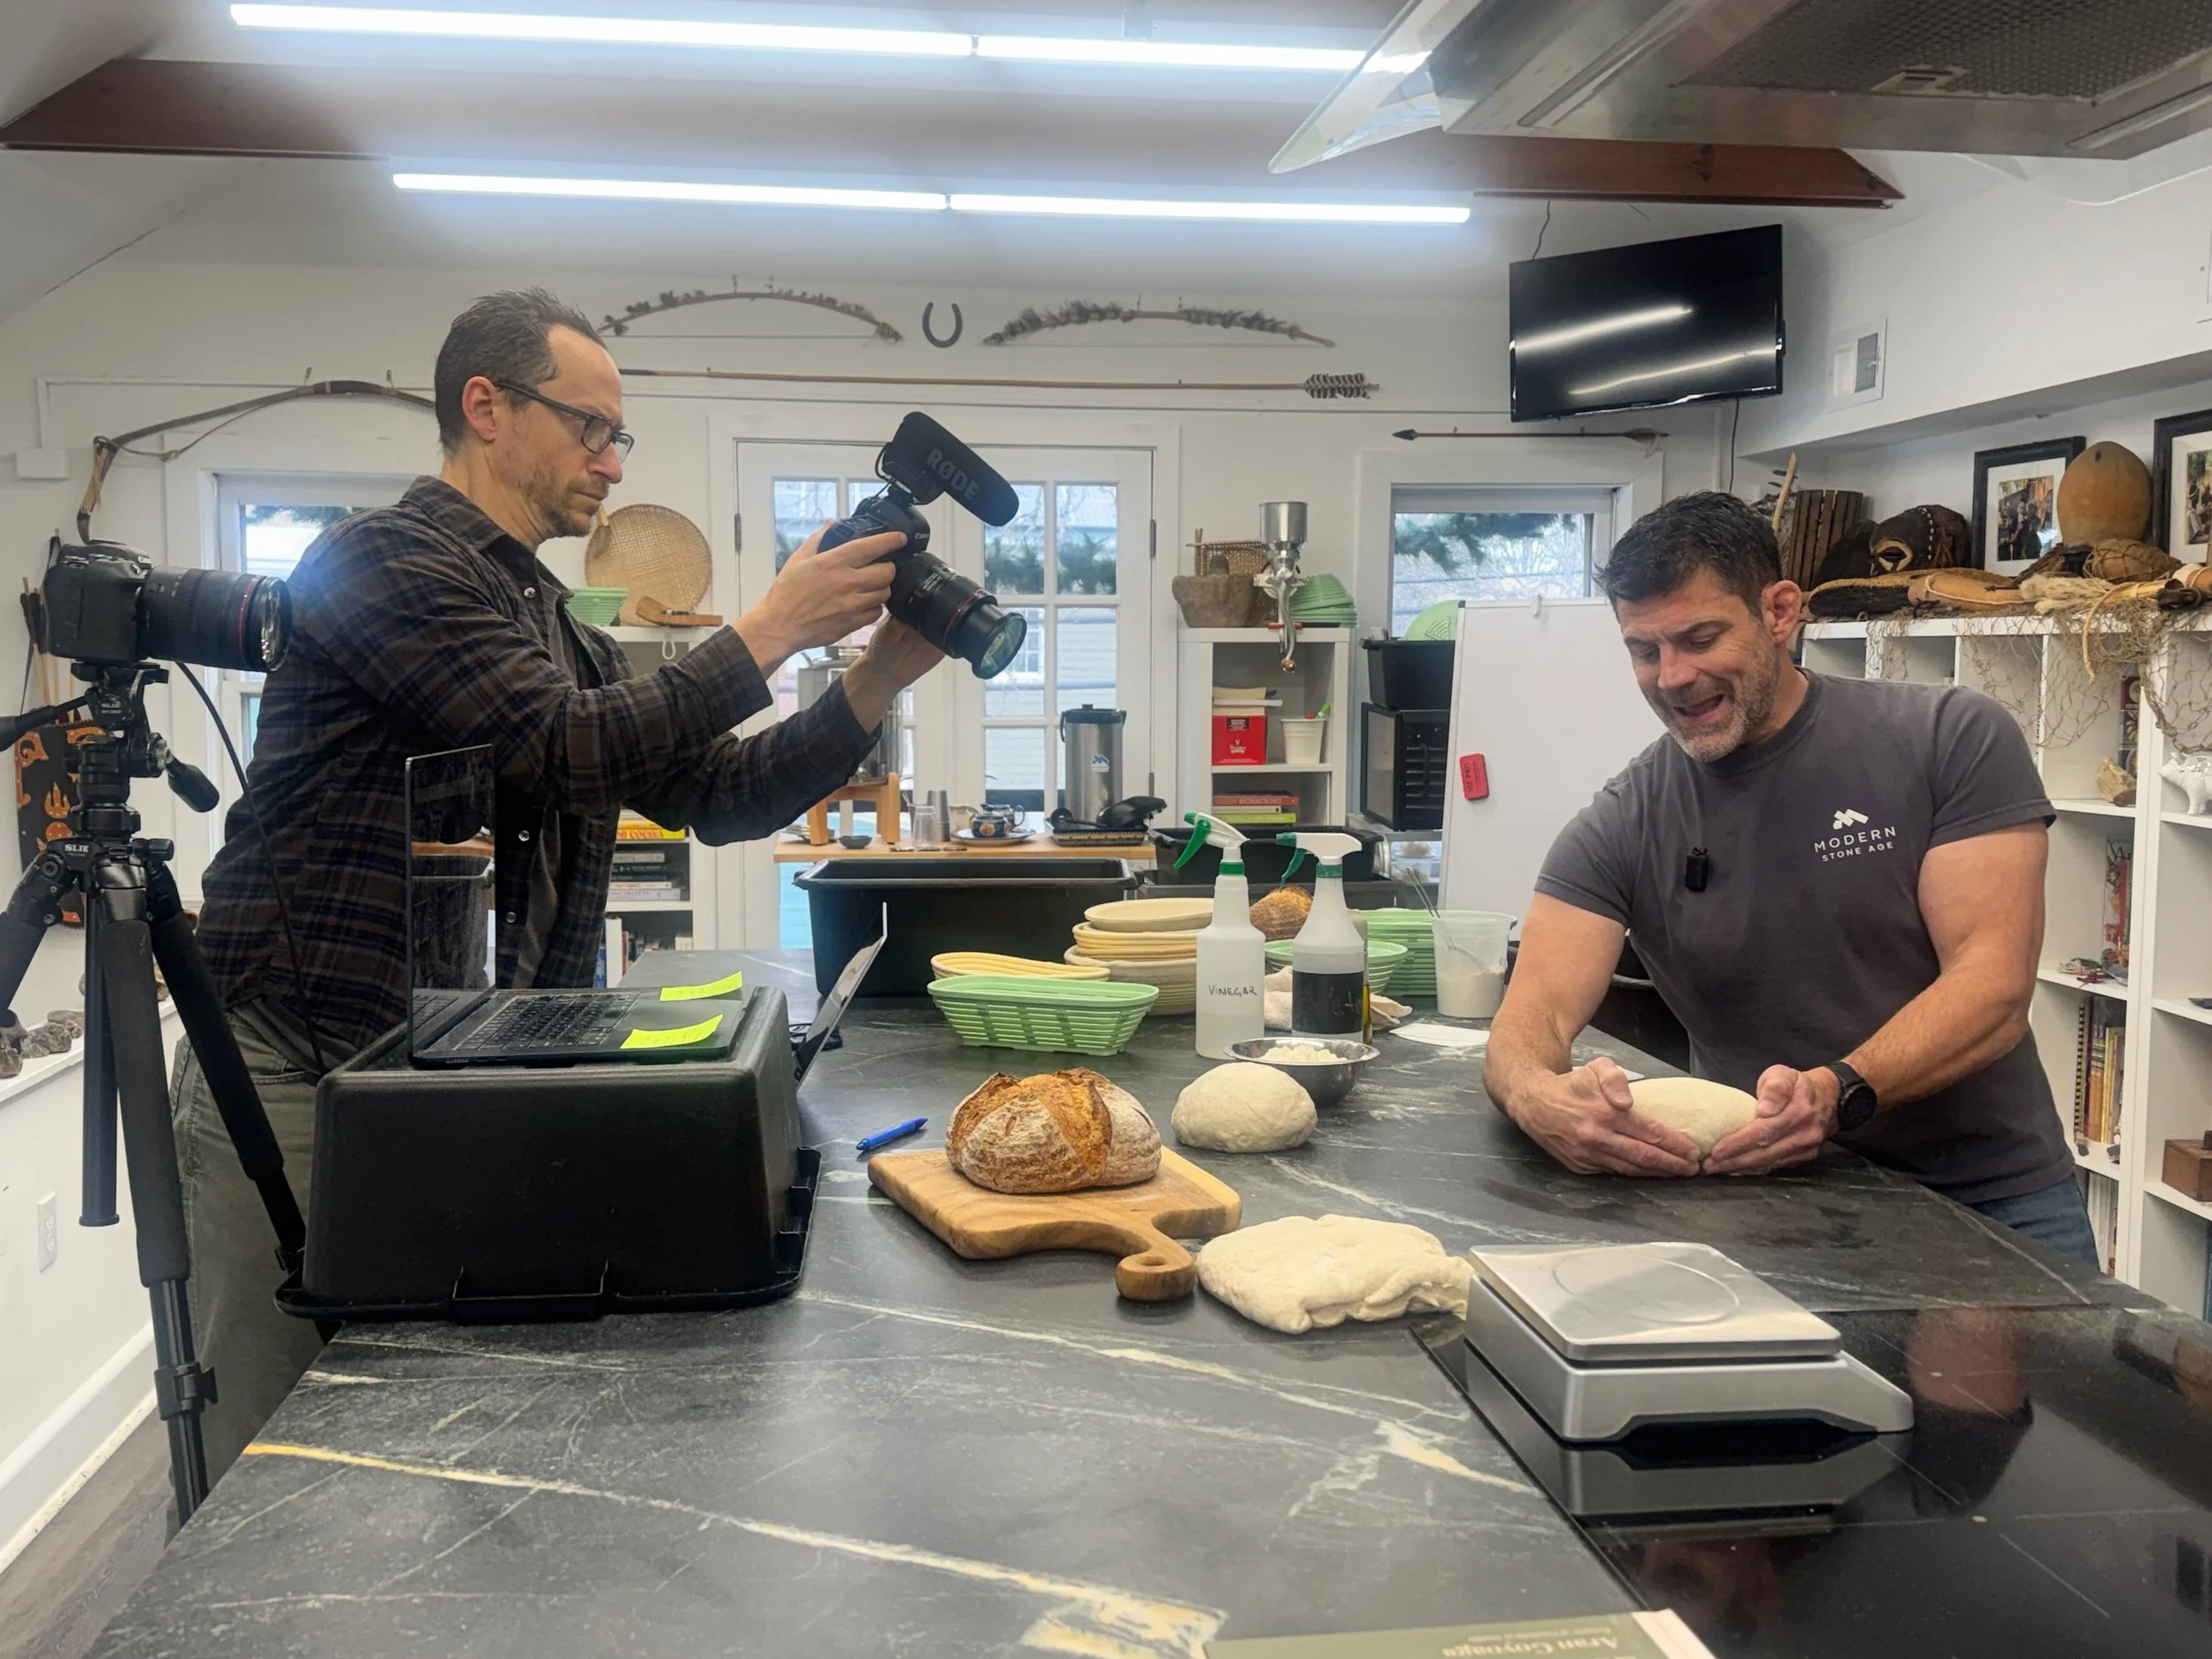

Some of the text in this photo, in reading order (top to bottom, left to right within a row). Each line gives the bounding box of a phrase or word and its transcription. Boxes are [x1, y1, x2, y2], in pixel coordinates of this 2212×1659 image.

[926, 448, 981, 502] RØDE
[65, 843, 89, 853] SLIK
[1814, 826, 1897, 853] MODERN
[1822, 841, 1894, 862] STONE AGE
[1208, 984, 1257, 997] VINEGAR
